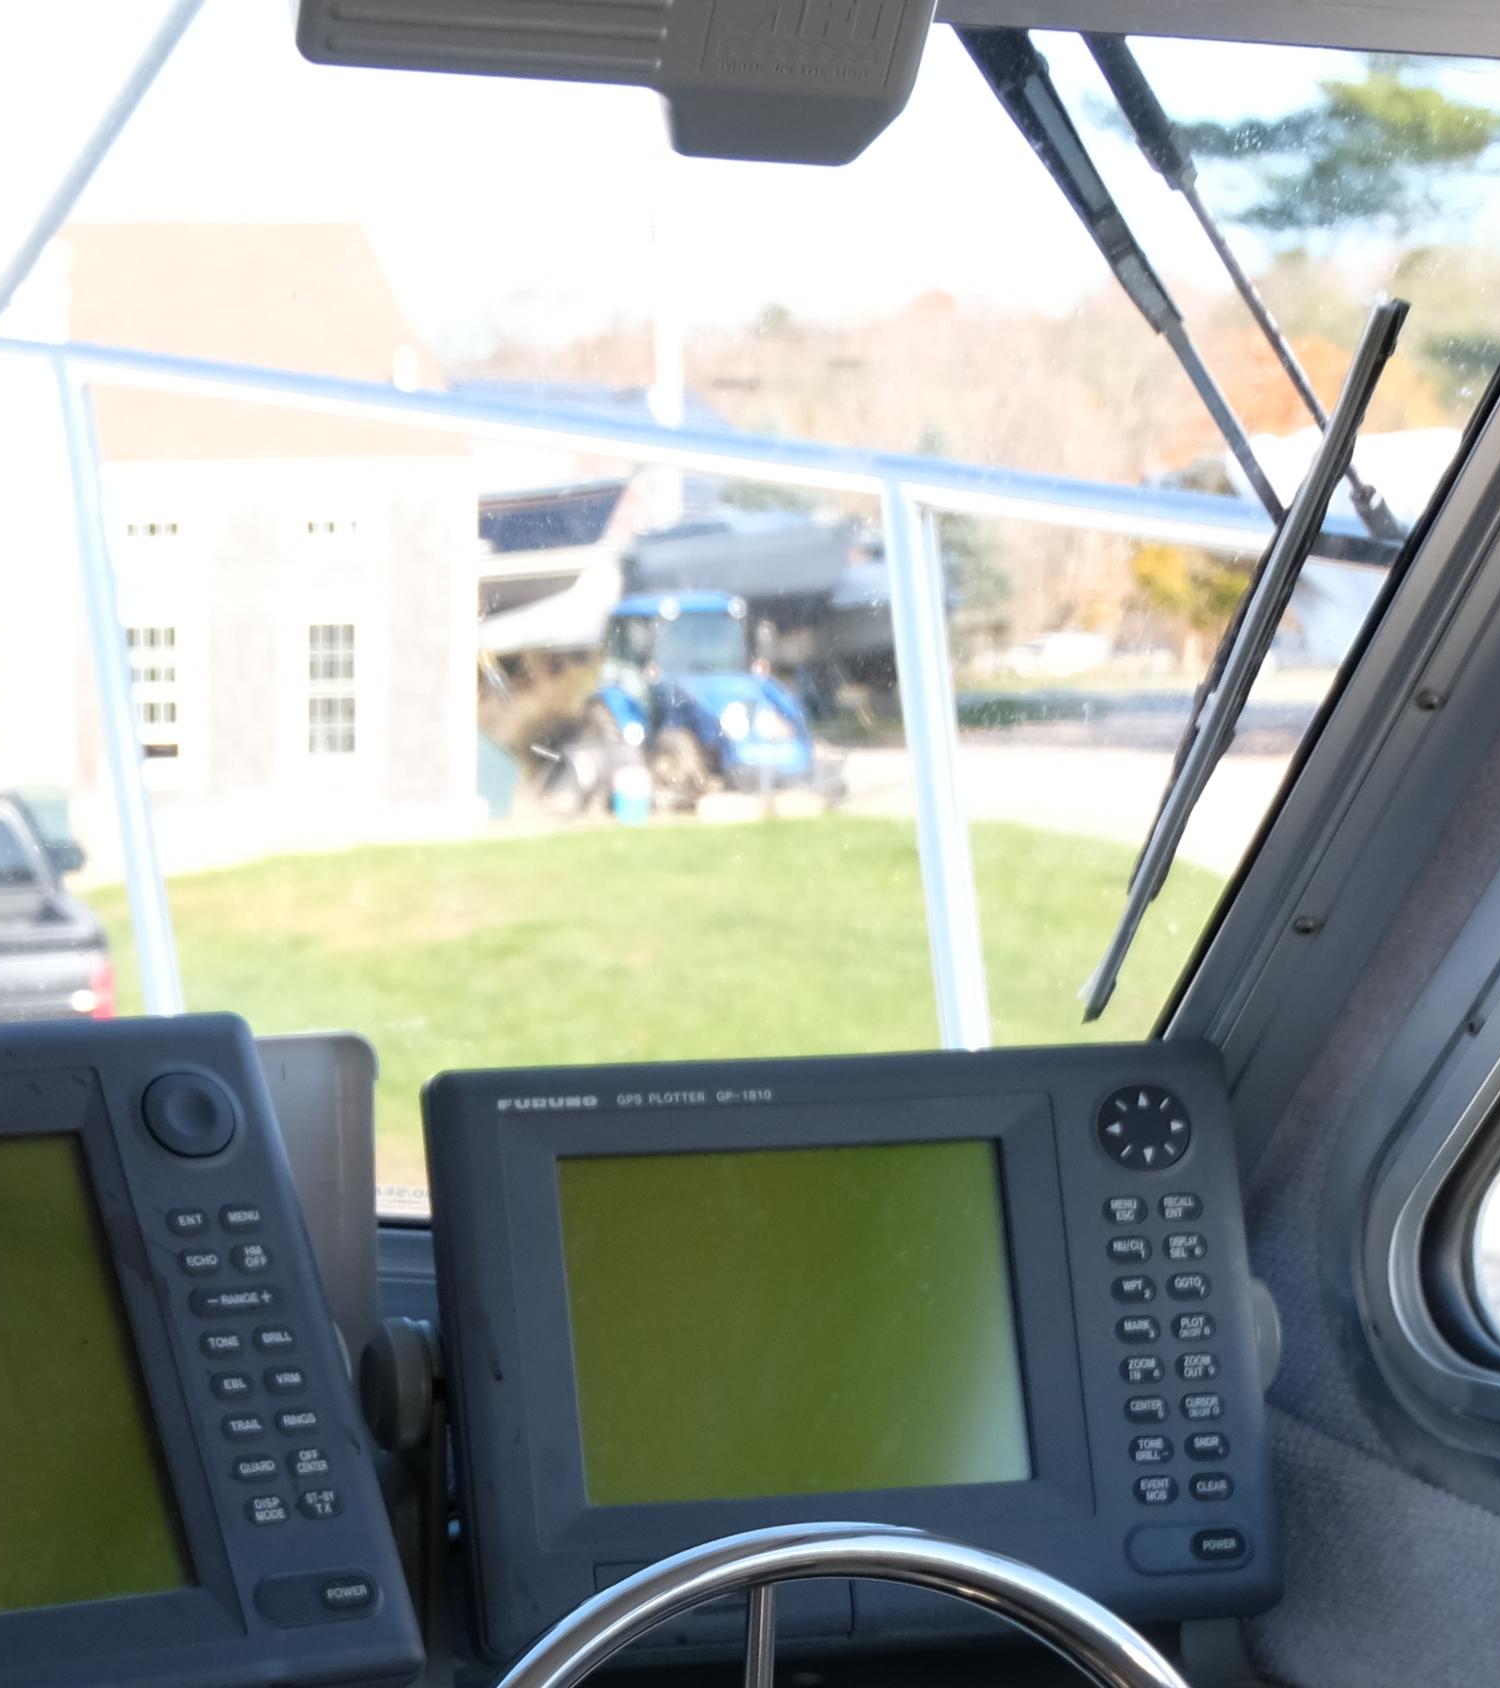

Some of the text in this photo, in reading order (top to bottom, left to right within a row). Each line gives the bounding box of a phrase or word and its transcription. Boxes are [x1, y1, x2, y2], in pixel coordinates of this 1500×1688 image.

[497, 1096, 598, 1111] FURUNO
[617, 1094, 642, 1106] GPS
[649, 1092, 706, 1105] PLOTTER
[1110, 1198, 1137, 1210] MENU
[1163, 1197, 1194, 1207] RECALL
[228, 1210, 260, 1222] MENU
[1165, 1207, 1183, 1218] ENT
[178, 1214, 203, 1226] ENT
[1169, 1236, 1197, 1247] DISPLAY
[186, 1254, 218, 1267] ECHO
[244, 1255, 268, 1267] OFF
[1122, 1280, 1143, 1292] WPT
[1174, 1277, 1201, 1288] GOTO
[220, 1292, 259, 1305] RANGE
[1124, 1319, 1150, 1331] MARK
[1180, 1317, 1204, 1328] PLOT
[208, 1336, 240, 1348] TONE
[262, 1331, 293, 1344] BRILL
[1128, 1358, 1156, 1369] ZOOM
[1184, 1355, 1211, 1367] ZOOM
[275, 1372, 301, 1384] VRM
[1184, 1367, 1203, 1378] OUT
[223, 1377, 247, 1390] EBL
[1130, 1400, 1163, 1411] CENTER
[1186, 1396, 1218, 1408] CURSOR
[229, 1419, 262, 1431] TRAIL
[283, 1413, 316, 1426] RINGS
[1138, 1438, 1164, 1450] TONE
[299, 1449, 318, 1461] OFF
[239, 1460, 275, 1474] GUARD
[296, 1460, 328, 1473] CENTER
[1140, 1478, 1169, 1490] EVENT
[1196, 1479, 1227, 1491] CLEAR
[254, 1497, 280, 1509] DISP
[255, 1508, 286, 1521] MODE
[1203, 1537, 1236, 1550] POWER
[327, 1585, 367, 1599] POWER
